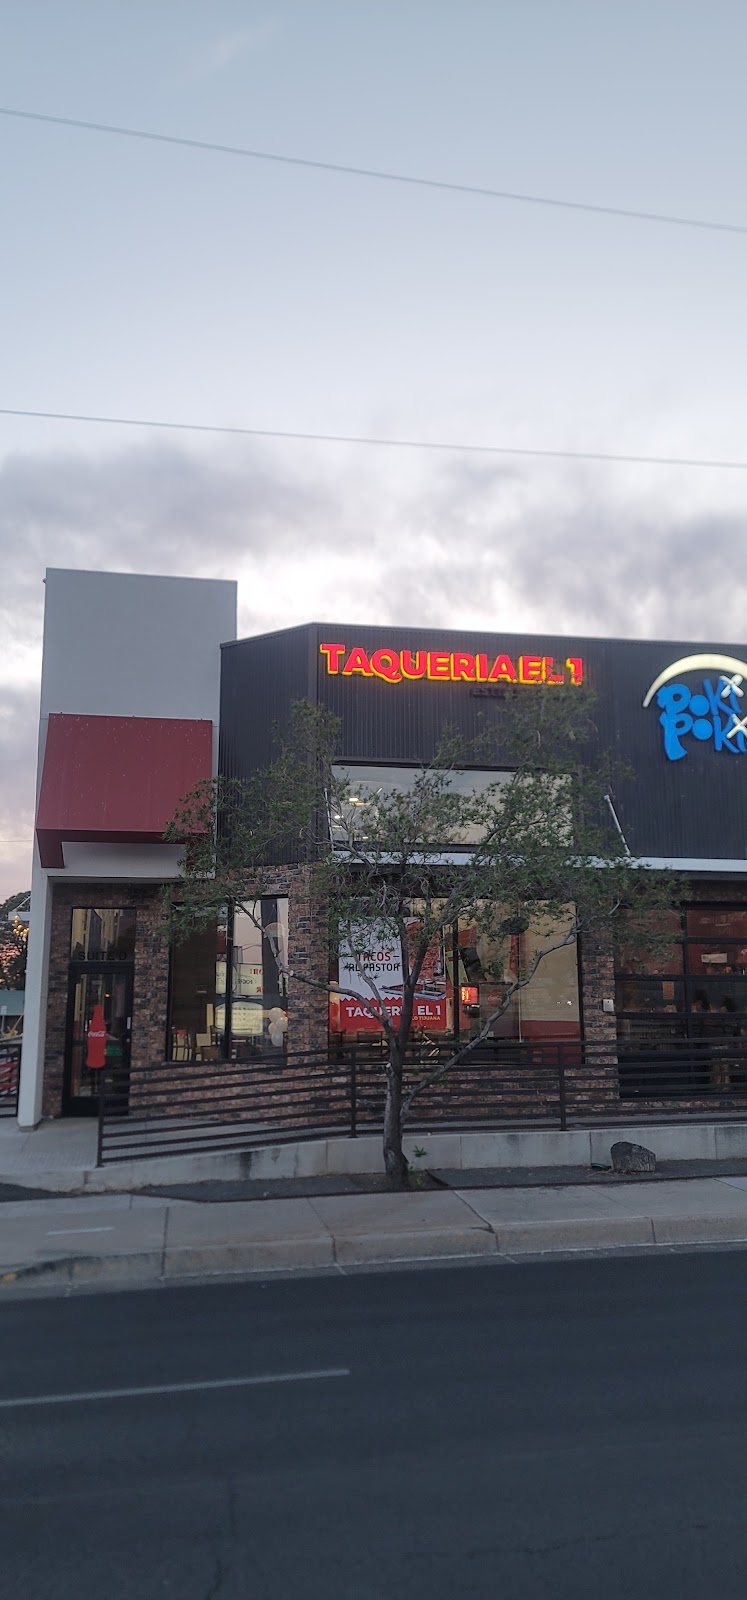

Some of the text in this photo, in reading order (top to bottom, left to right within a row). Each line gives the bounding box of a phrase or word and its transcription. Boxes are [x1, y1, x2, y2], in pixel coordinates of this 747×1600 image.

[320, 643, 583, 686] TAQUERIA EL 1
[79, 951, 115, 961] SUITE
[357, 951, 391, 962] TACOS
[364, 963, 399, 972] PASTOR
[346, 1005, 413, 1019] TAQUER
[417, 1005, 433, 1016] EL
[435, 1005, 441, 1016] 1
